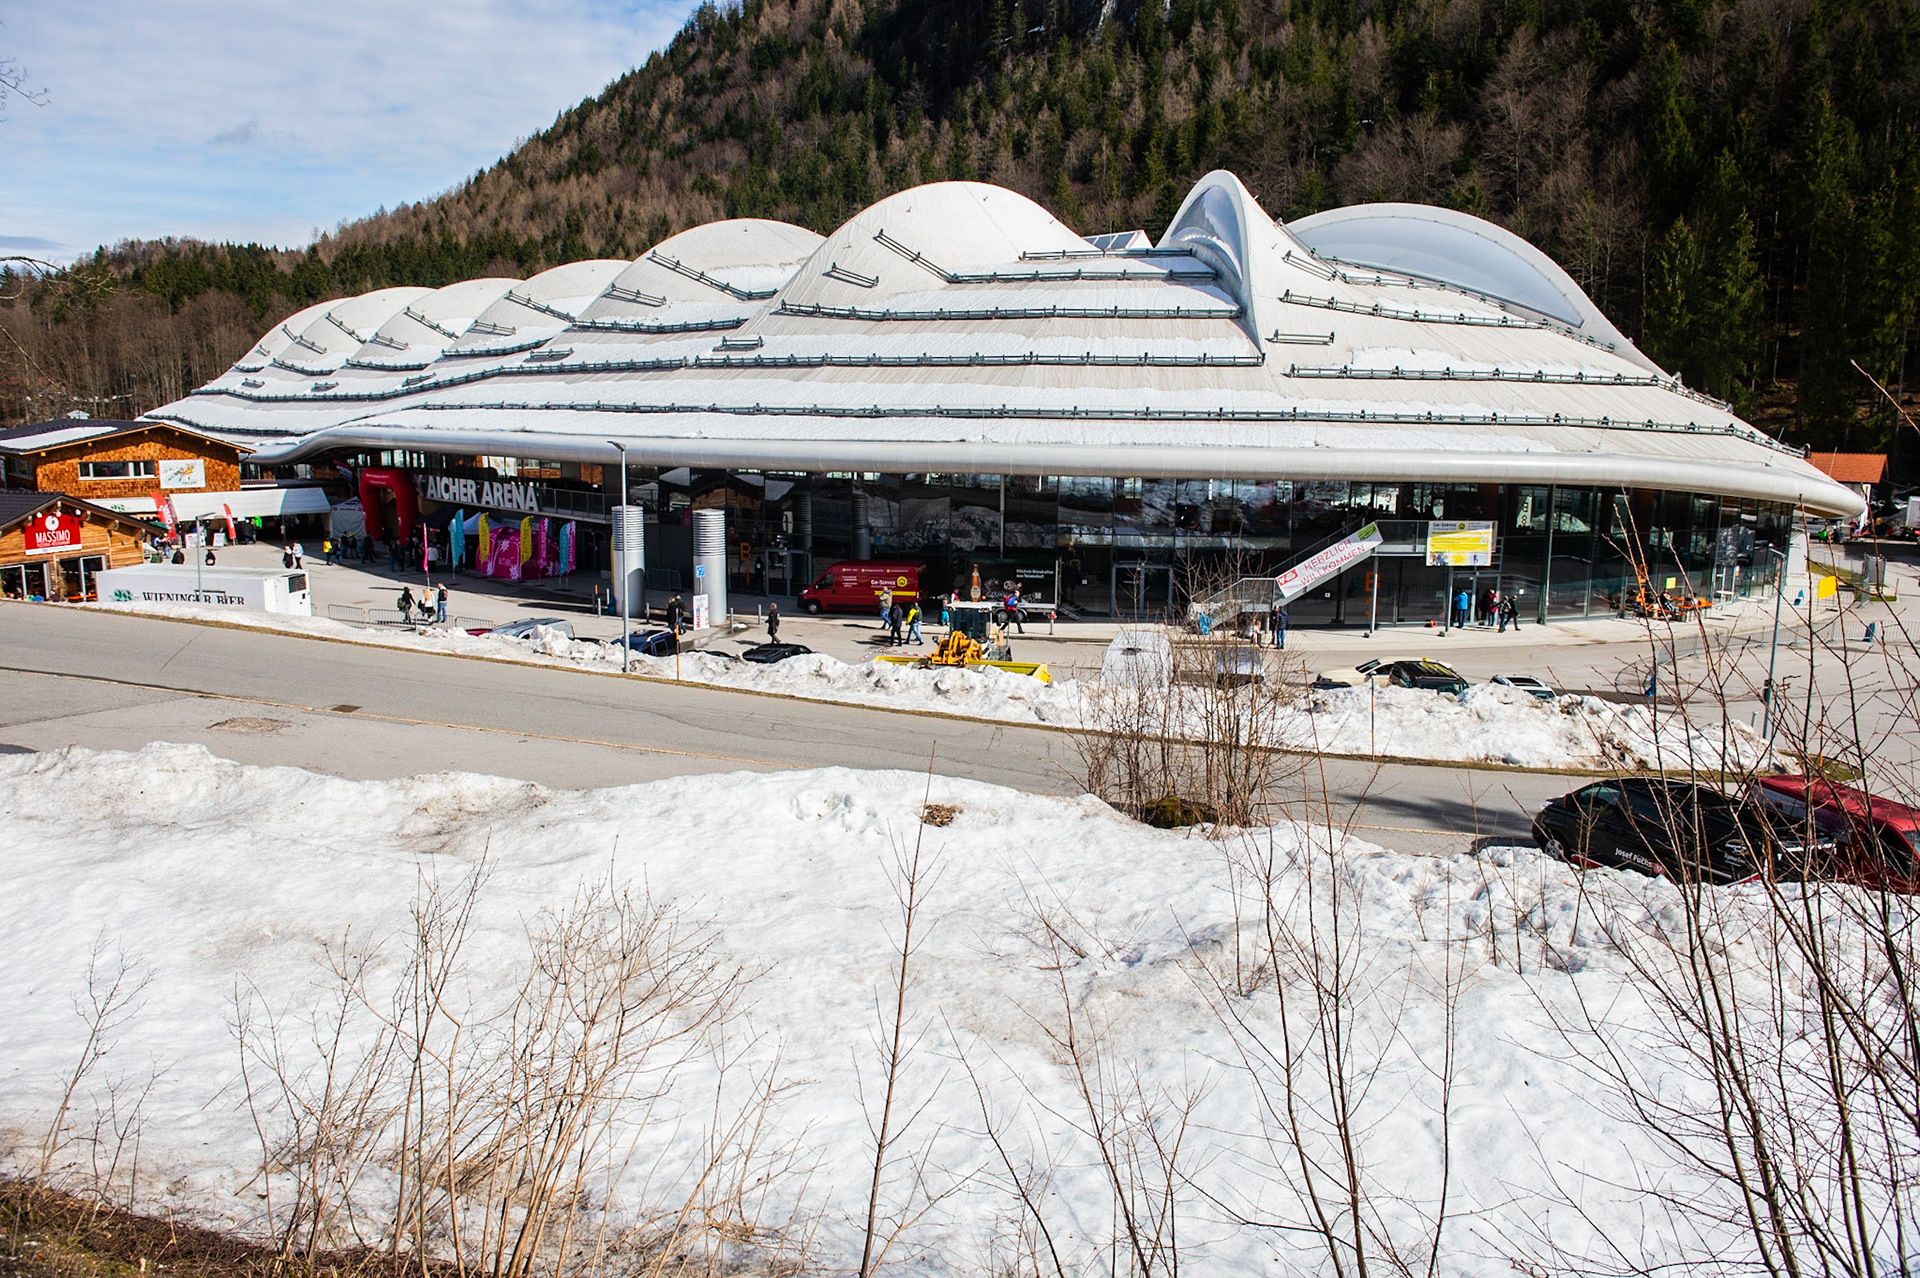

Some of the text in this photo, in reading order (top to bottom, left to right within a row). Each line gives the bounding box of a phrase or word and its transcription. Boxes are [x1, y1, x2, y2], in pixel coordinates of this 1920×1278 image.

[427, 475, 477, 504] AICHER
[481, 481, 539, 512] ARENA
[36, 530, 70, 543] MASSIMO
[740, 542, 752, 560] B
[1304, 539, 1352, 570] HERZLICH
[1300, 544, 1366, 586] WILLKOMMEN
[142, 592, 211, 603] WIENINGR
[1615, 848, 1633, 860] Josef
